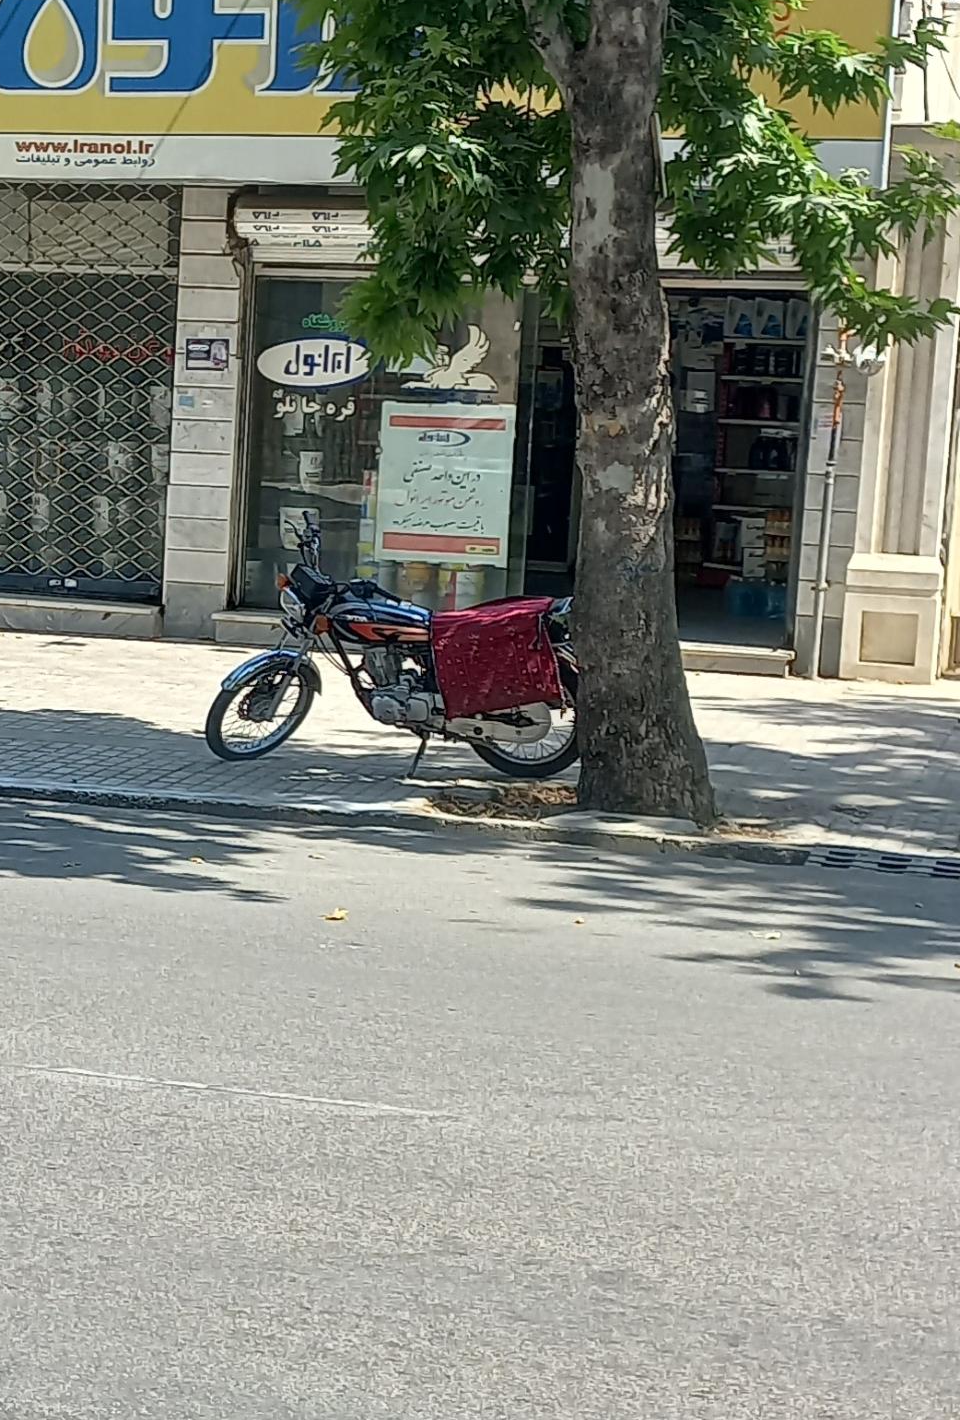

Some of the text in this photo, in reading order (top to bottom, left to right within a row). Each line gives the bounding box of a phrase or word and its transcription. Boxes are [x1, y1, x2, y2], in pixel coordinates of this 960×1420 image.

[63, 157, 71, 167] و
[74, 157, 118, 168] عمومی
[284, 344, 352, 376] ایرانول
[326, 396, 355, 421] قره
